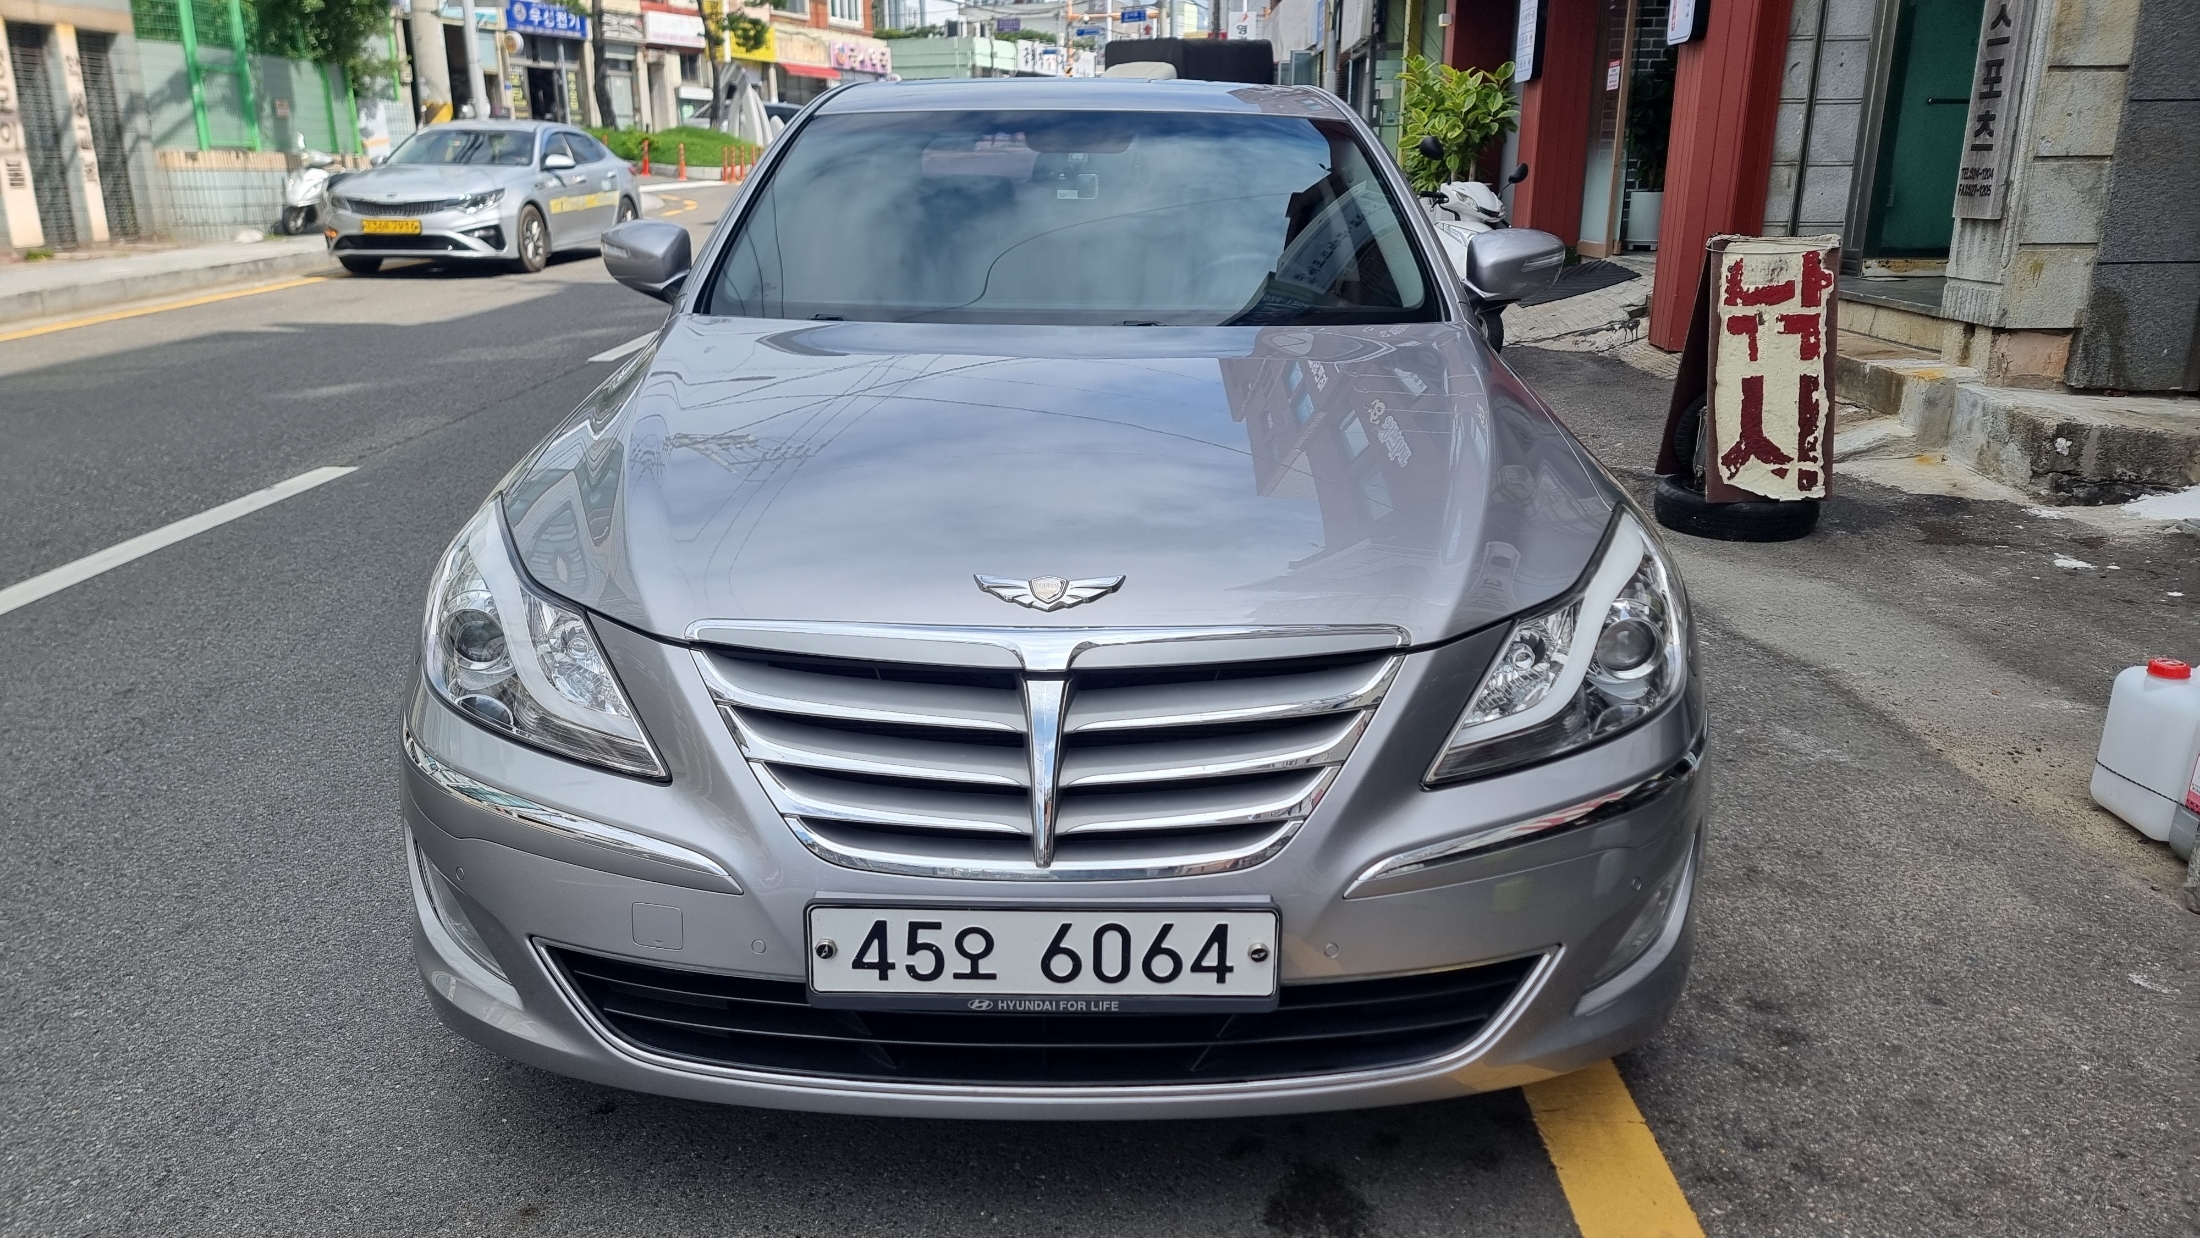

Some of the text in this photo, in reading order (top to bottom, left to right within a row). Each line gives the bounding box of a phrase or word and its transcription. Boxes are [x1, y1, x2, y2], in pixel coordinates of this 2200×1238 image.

[1971, 3, 2012, 152] 스포츠
[851, 919, 1235, 985] 45오 6064
[998, 1000, 1120, 1012] HYUNDAI FOR LIFE
